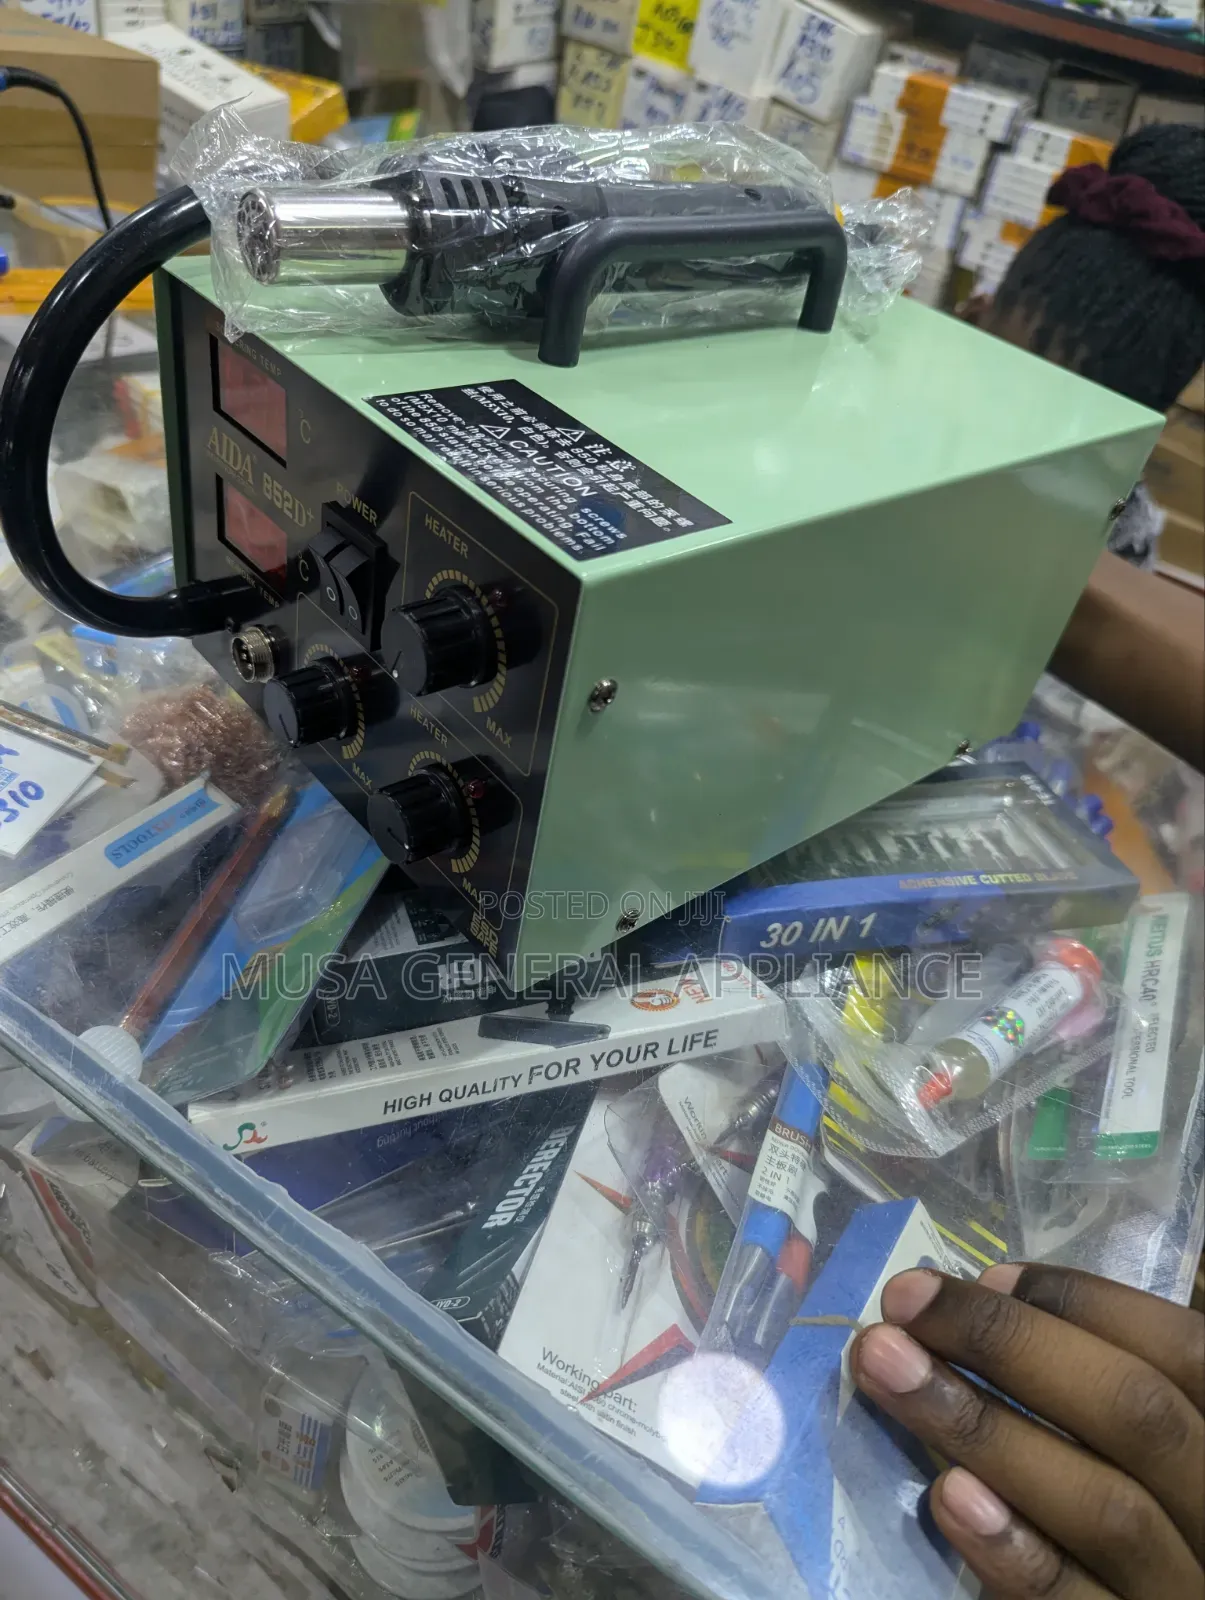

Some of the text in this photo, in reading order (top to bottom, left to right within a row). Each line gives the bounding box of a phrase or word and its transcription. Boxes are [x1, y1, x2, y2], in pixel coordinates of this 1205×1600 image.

[375, 398, 389, 406] to
[386, 407, 402, 416] do
[399, 417, 416, 426] so
[412, 426, 439, 442] may
[478, 475, 525, 507] serious
[508, 440, 597, 496] CAUTION
[570, 447, 598, 463] 850
[401, 404, 421, 417] the
[418, 417, 443, 431] 850
[438, 432, 482, 459] station
[575, 531, 606, 550] Fail
[485, 441, 524, 463] pump
[580, 507, 627, 538] screws
[336, 481, 378, 527] POWER
[545, 495, 567, 510] the
[567, 512, 614, 544] bottom
[424, 513, 470, 559] HEATER
[410, 704, 449, 748] HEATER
[486, 716, 512, 748] MAX
[352, 762, 373, 790] MAX
[978, 872, 1033, 885] CUTTED
[469, 920, 498, 960] SAFE
[472, 911, 498, 944] ESD
[760, 912, 878, 949] 30 IN 1
[383, 1028, 719, 1116] HIGH QUALITY FOR YOUR LIFE
[774, 1123, 812, 1149] BRUSH
[542, 1346, 600, 1396] Working
[615, 1415, 637, 1437] finish
